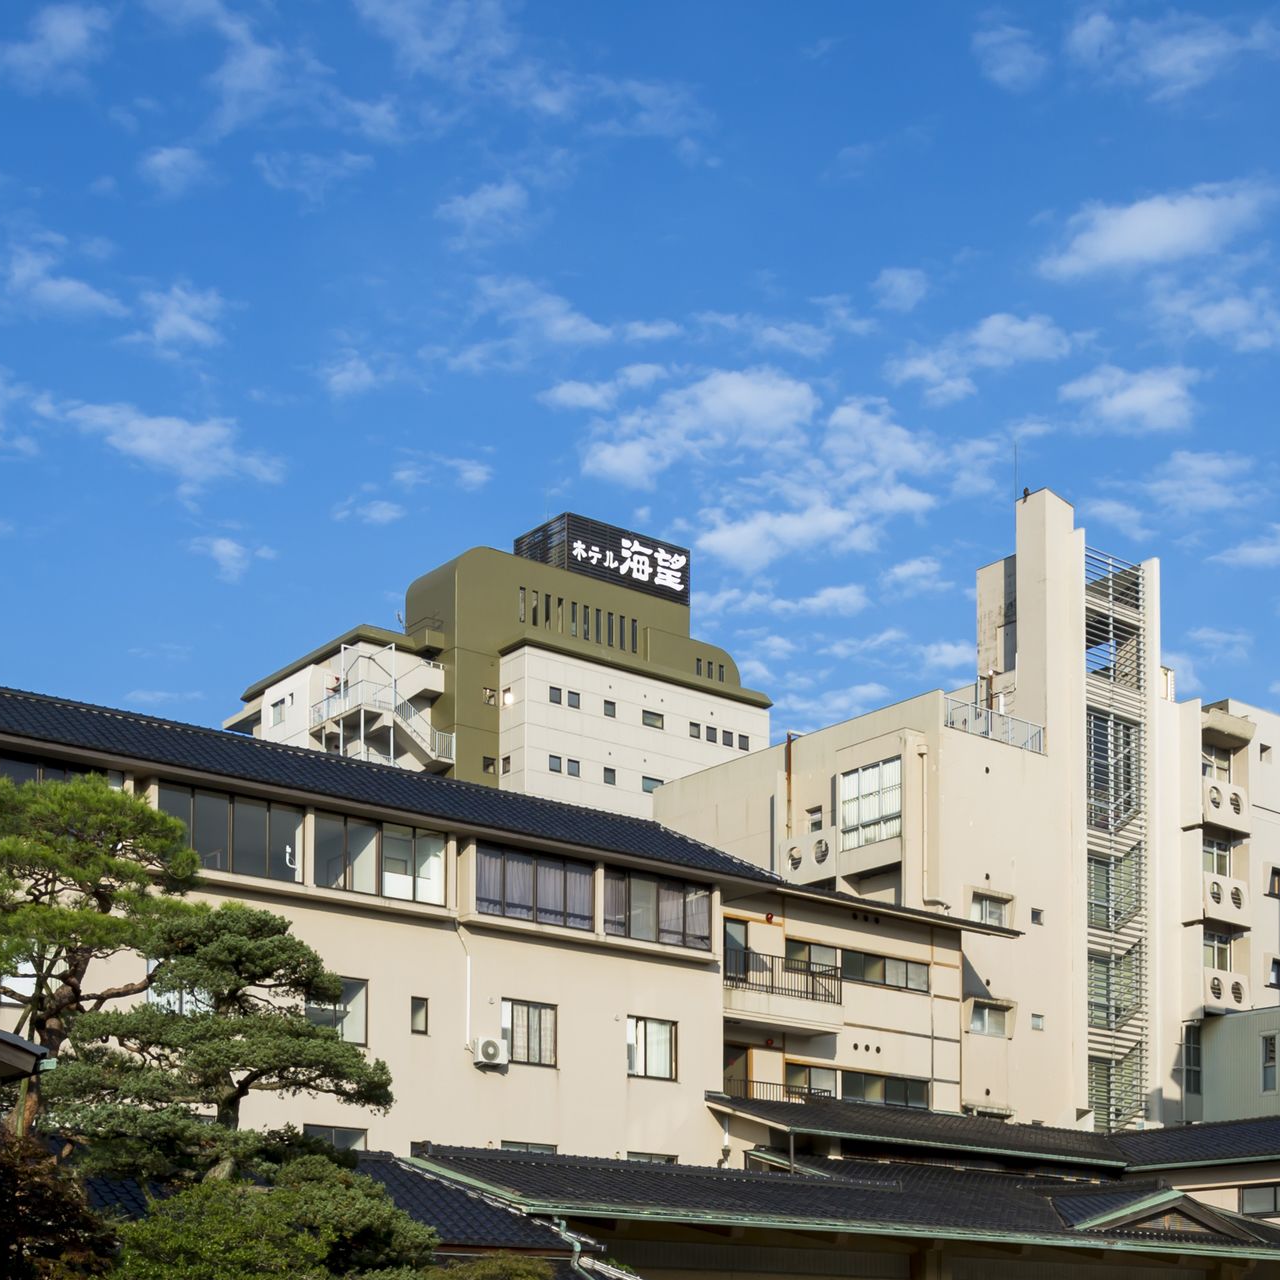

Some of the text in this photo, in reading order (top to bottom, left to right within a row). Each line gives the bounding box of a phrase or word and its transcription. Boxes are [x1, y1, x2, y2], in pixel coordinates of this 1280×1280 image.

[572, 538, 686, 591] ホテル海望
